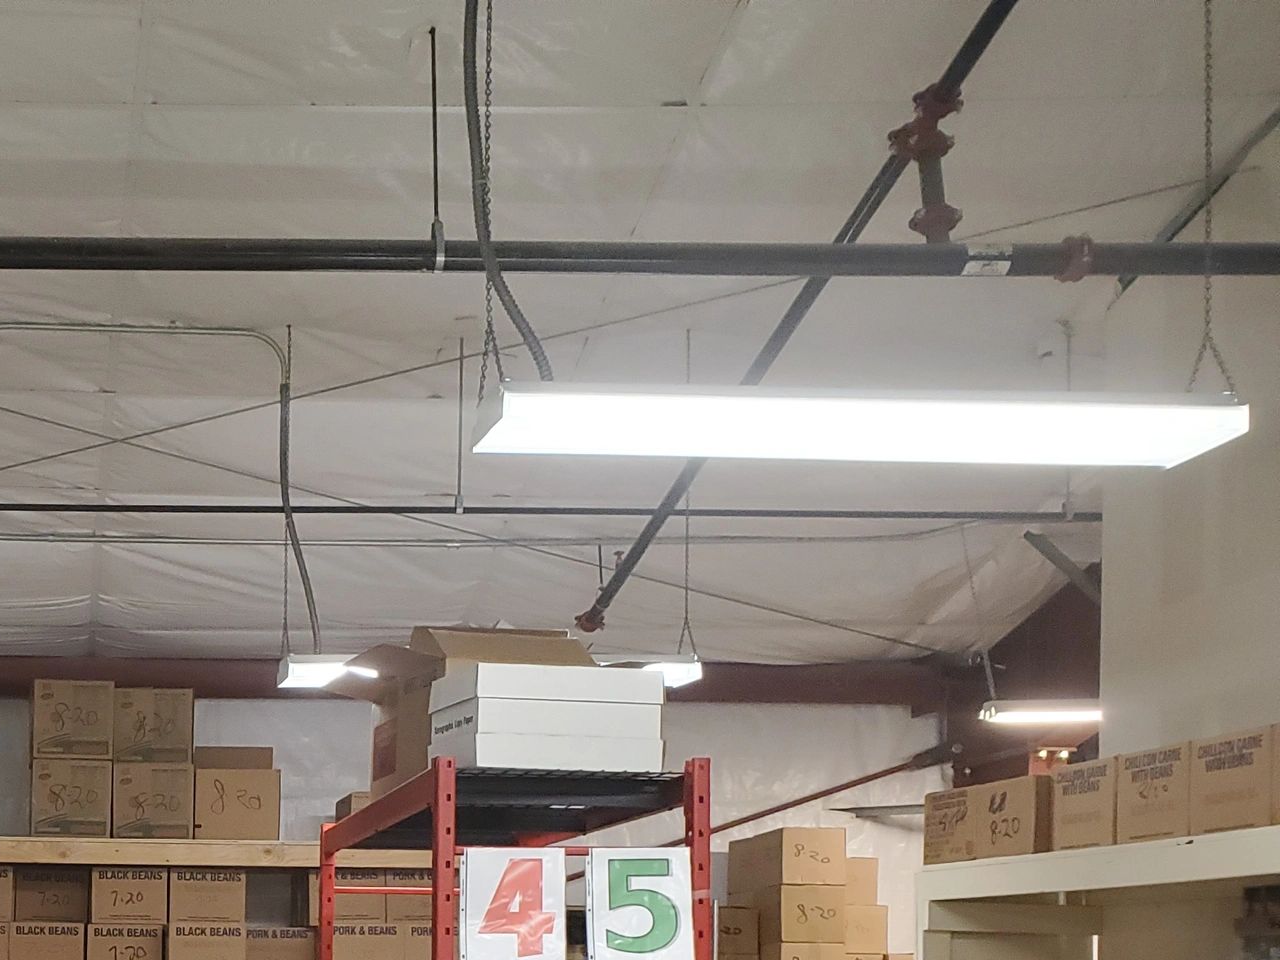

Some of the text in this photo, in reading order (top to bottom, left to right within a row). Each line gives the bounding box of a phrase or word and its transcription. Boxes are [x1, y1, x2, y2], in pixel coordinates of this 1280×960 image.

[1157, 747, 1181, 765] CARNE
[1150, 763, 1173, 780] BEANS
[98, 870, 163, 881] BLACK BEANS
[176, 871, 241, 883] BLACK BEANS
[478, 857, 555, 957] 4
[605, 857, 679, 953] 5
[796, 903, 836, 925] 8-20
[15, 925, 79, 937] BLACK BEANS
[93, 927, 158, 938] BLACK BEANS
[175, 926, 241, 938] BLACK BEANS
[246, 929, 308, 939] PORK & BEANS
[333, 926, 397, 937] PORK & BEANS
